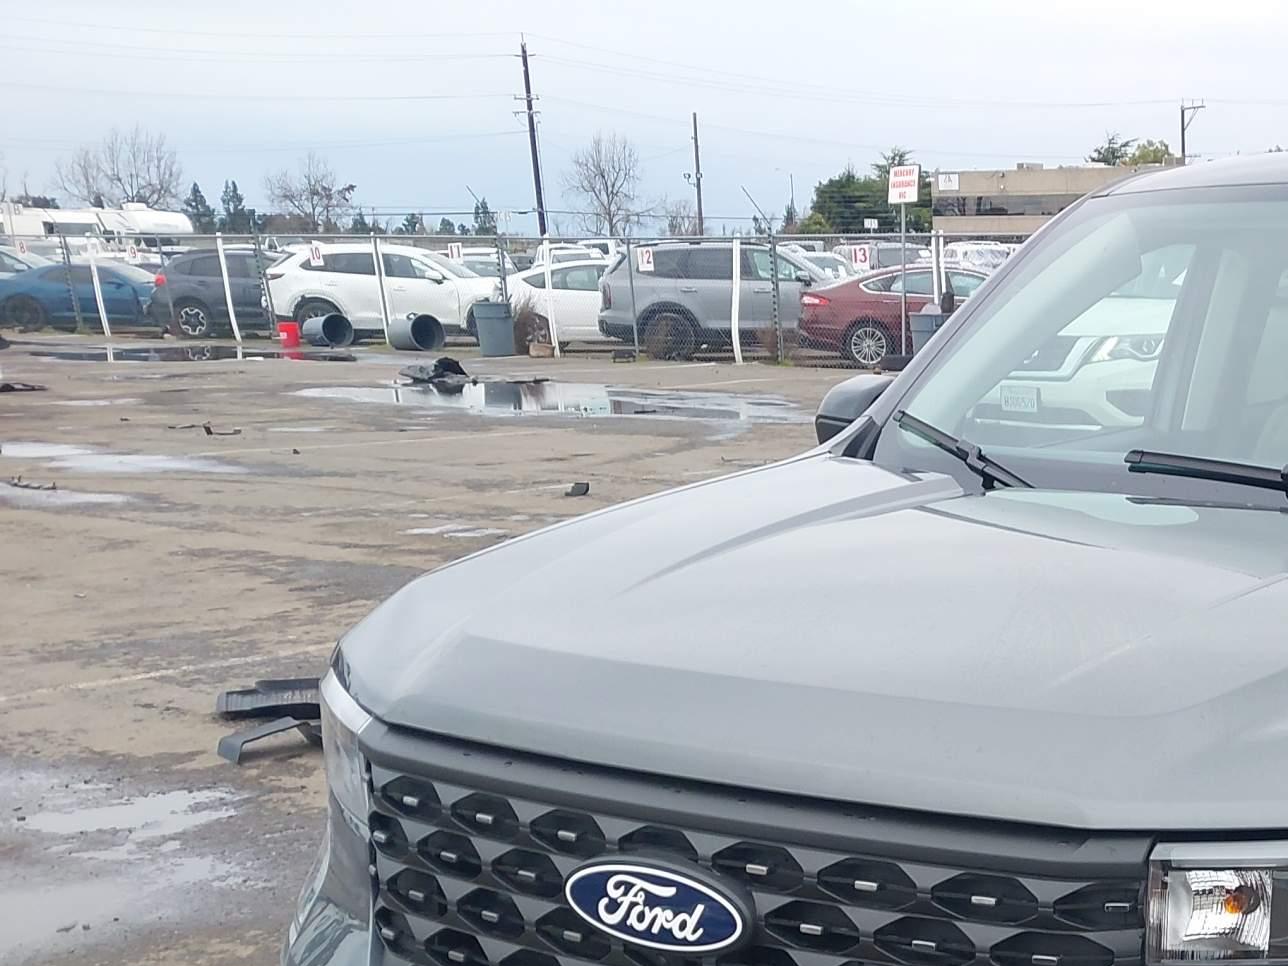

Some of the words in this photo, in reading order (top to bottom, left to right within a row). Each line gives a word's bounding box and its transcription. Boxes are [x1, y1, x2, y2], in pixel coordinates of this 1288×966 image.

[310, 246, 321, 262] 10
[450, 244, 462, 259] 11
[639, 249, 653, 266] 12
[853, 247, 868, 264] 13
[597, 873, 706, 943] Ford
